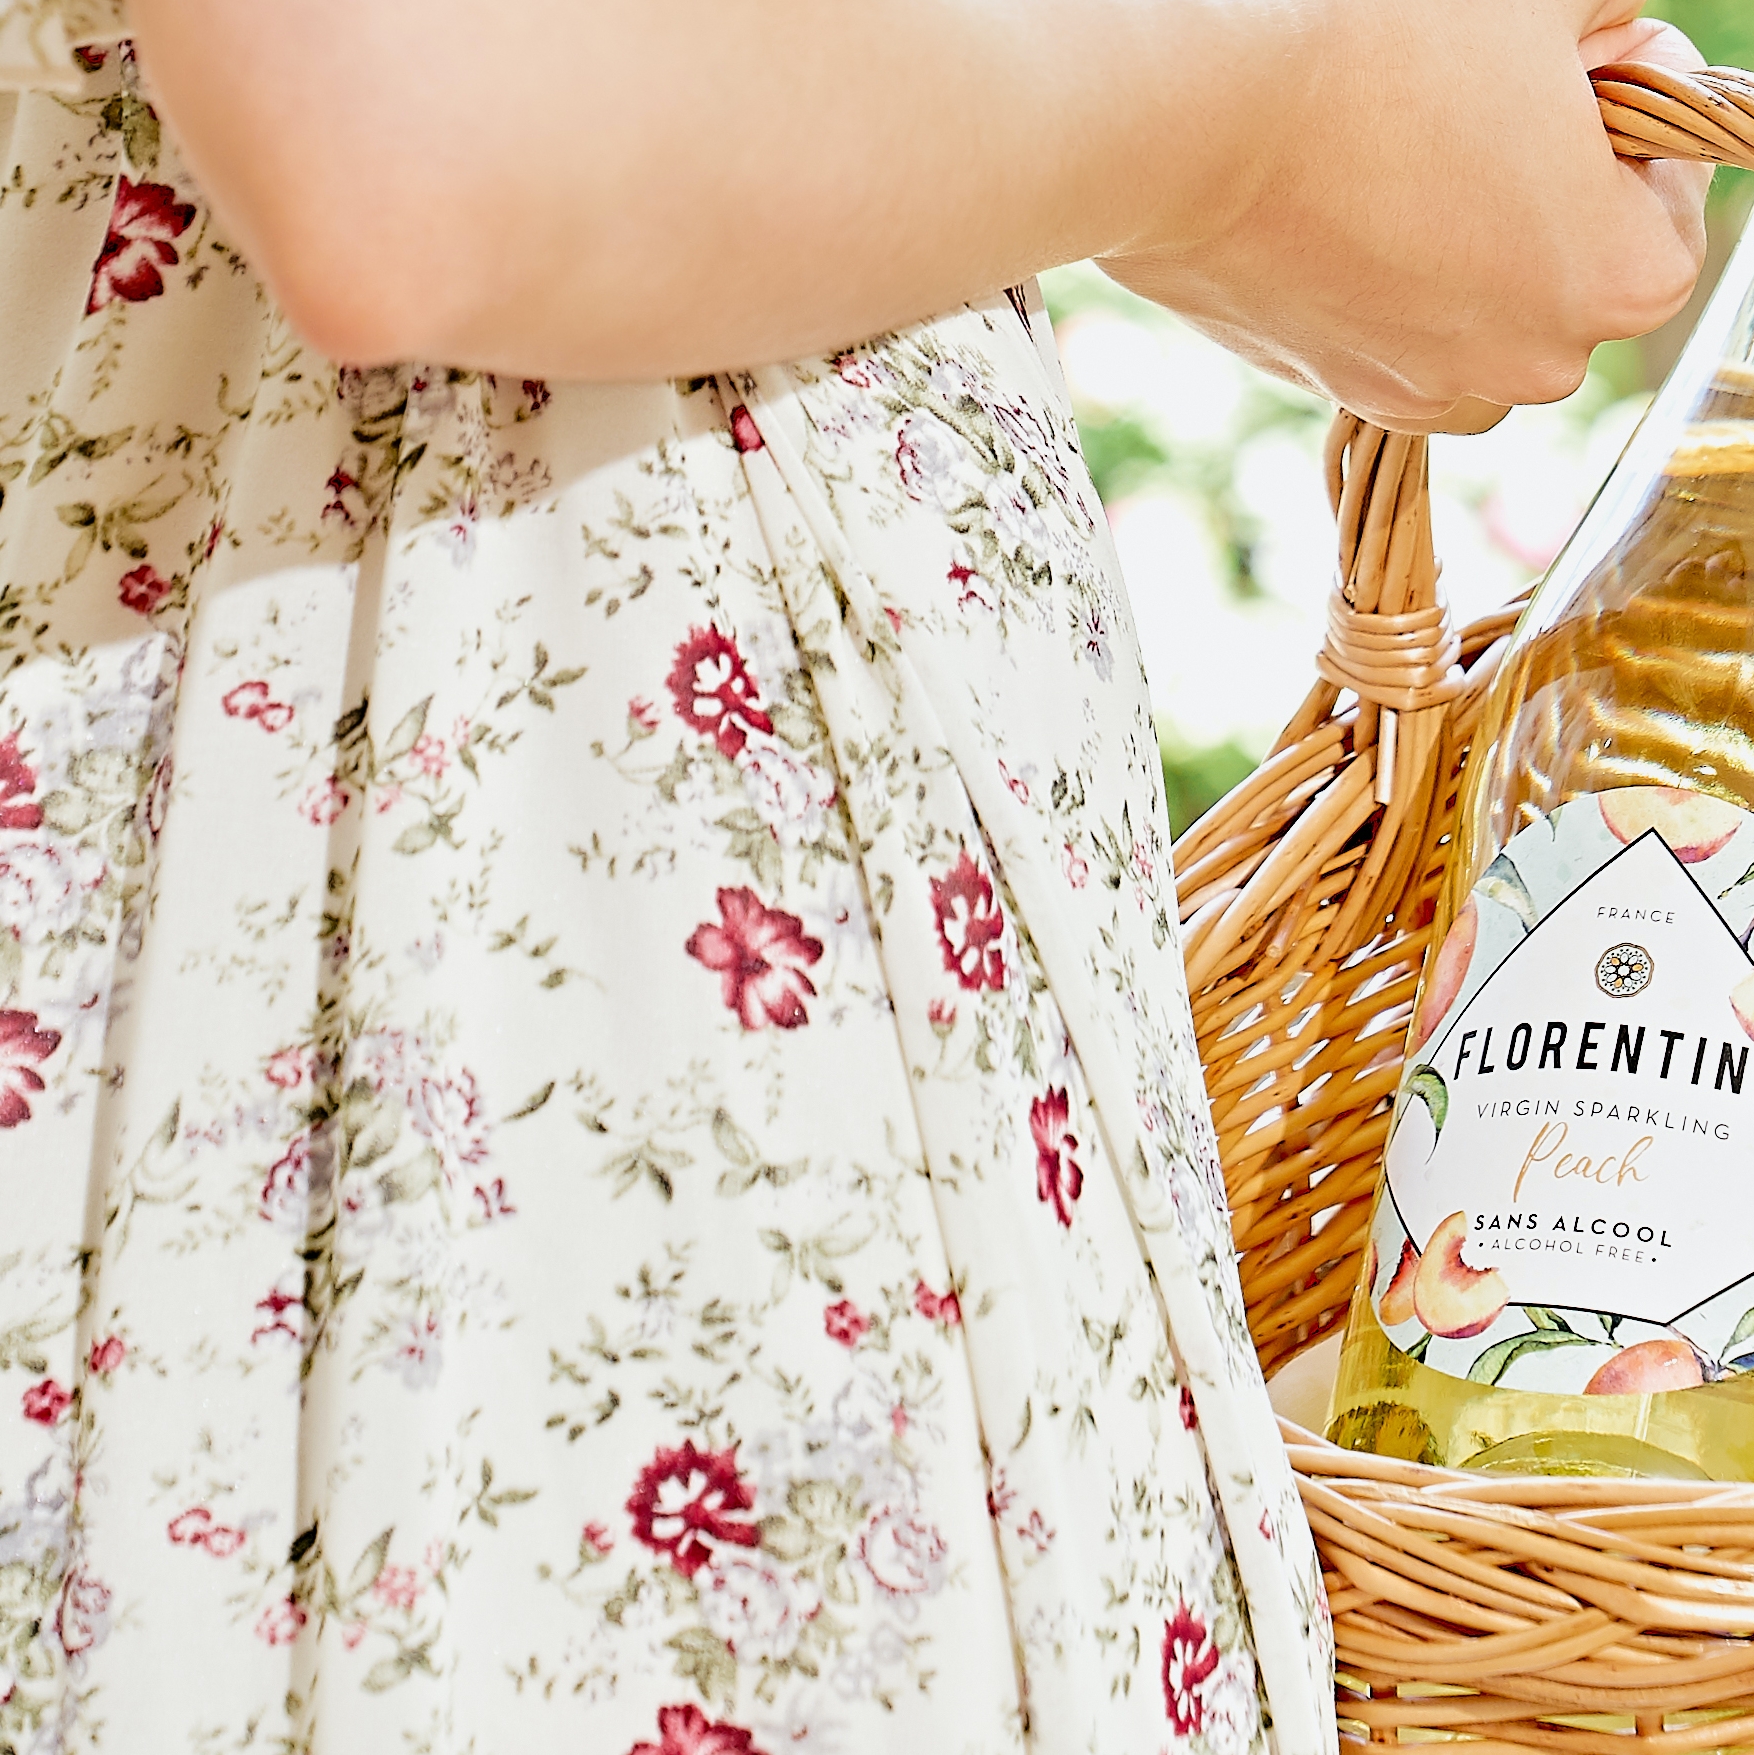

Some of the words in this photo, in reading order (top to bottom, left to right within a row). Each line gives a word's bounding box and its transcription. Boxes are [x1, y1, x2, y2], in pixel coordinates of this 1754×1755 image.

[1596, 906, 1676, 925] FRANCE
[1477, 1099, 1560, 1119] VIRGIN
[1573, 1100, 1730, 1141] SPARKLING
[1513, 1121, 1652, 1203] Peach
[1473, 1213, 1538, 1231] SANS
[1552, 1215, 1672, 1248] ALCOOL
[1490, 1237, 1583, 1255] ALCOHOL
[1595, 1244, 1645, 1264] FREE
